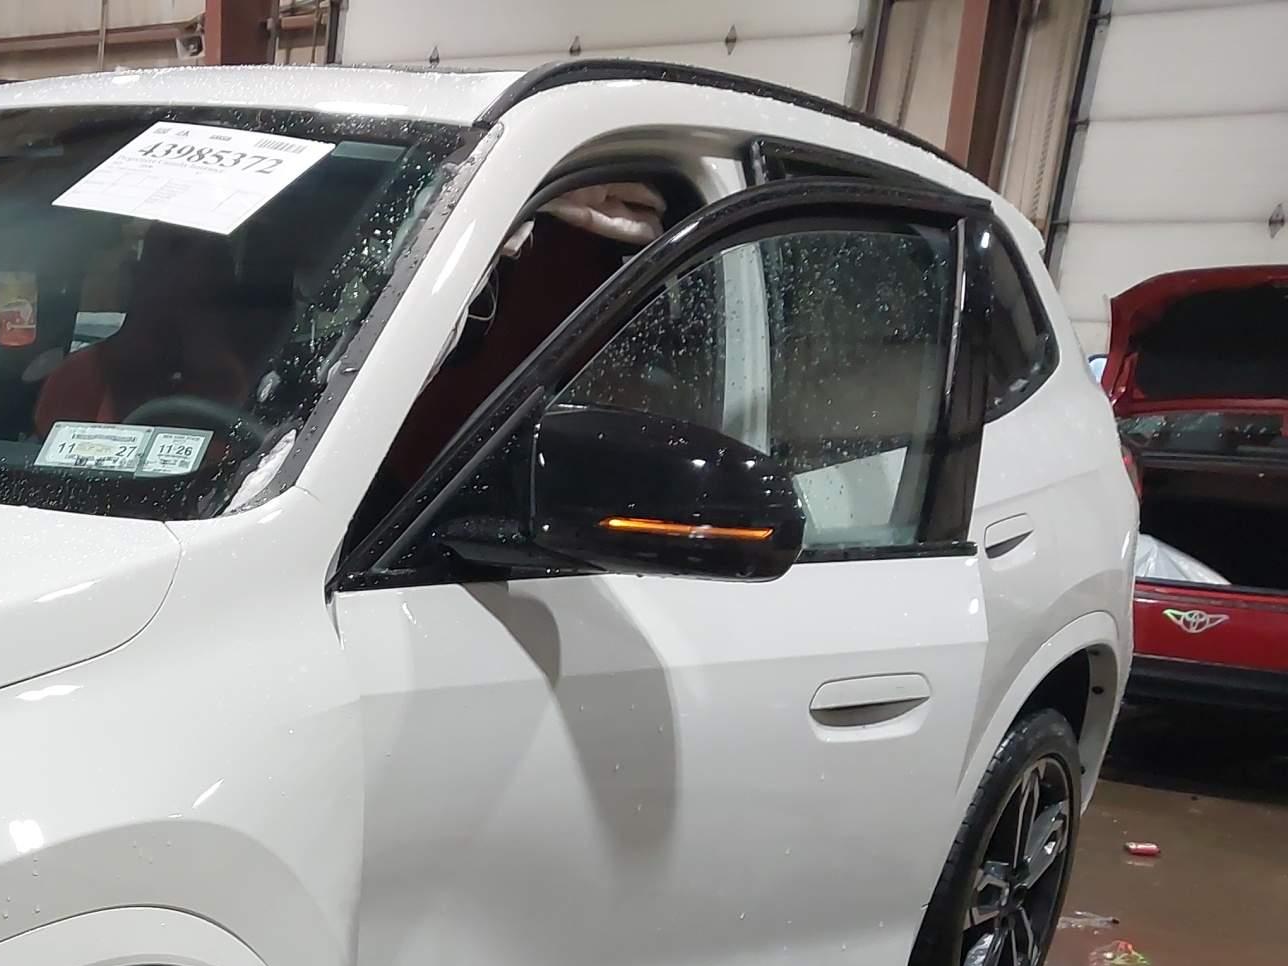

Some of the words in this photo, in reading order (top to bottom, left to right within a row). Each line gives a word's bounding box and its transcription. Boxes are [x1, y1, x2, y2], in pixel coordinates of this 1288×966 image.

[138, 142, 283, 174] 43985372
[58, 443, 76, 454] 11
[115, 446, 138, 458] 27
